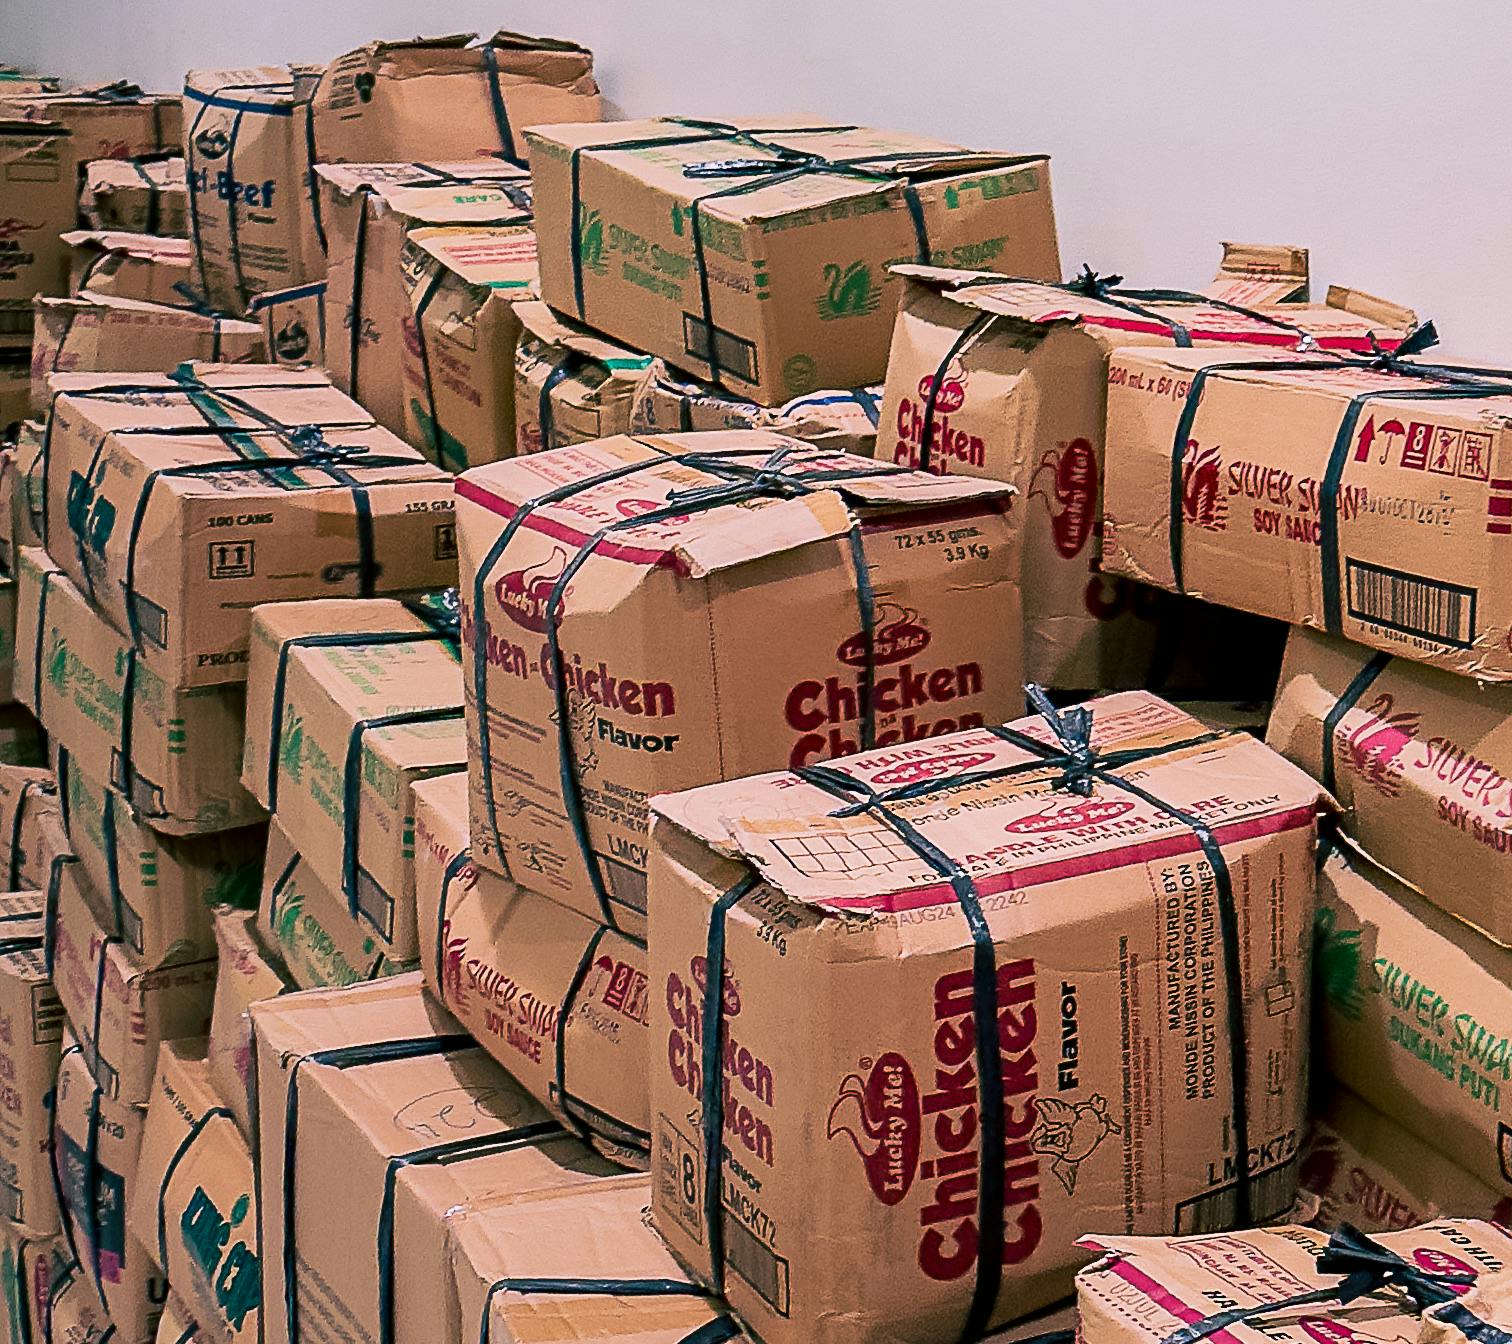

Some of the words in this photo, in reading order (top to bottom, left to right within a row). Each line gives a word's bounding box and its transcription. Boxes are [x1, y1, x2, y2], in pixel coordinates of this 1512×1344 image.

[897, 398, 985, 468] Chcken
[1227, 460, 1293, 508] SILVER
[235, 512, 275, 527] CANS
[1253, 507, 1282, 536] SOY
[1285, 515, 1322, 547] SAUC
[596, 716, 681, 754] Flavor
[1415, 736, 1505, 807] SILVER
[1016, 807, 1086, 832] Lucky
[1069, 815, 1150, 837] WITH
[1233, 794, 1281, 812] ONLY
[1436, 795, 1469, 832] SOY
[1161, 866, 1180, 894] BY:
[1177, 863, 1197, 980] CORPORATION
[1165, 897, 1182, 1032] MANUFACTURED
[1201, 959, 1215, 994] THE
[1183, 983, 1198, 1039] NISSIN
[1201, 996, 1216, 1019] OF
[1373, 957, 1449, 1038] SILVER
[666, 971, 775, 1108] Chken
[1058, 979, 1079, 1090] Flavor
[1200, 1022, 1217, 1099] PRODUCT
[667, 1028, 775, 1168] Chken
[883, 1065, 905, 1109] Me!
[1183, 1043, 1199, 1100] MONDE
[917, 967, 980, 1282] Chicken
[682, 1152, 697, 1205] 8
[882, 1113, 906, 1194] Lucky
